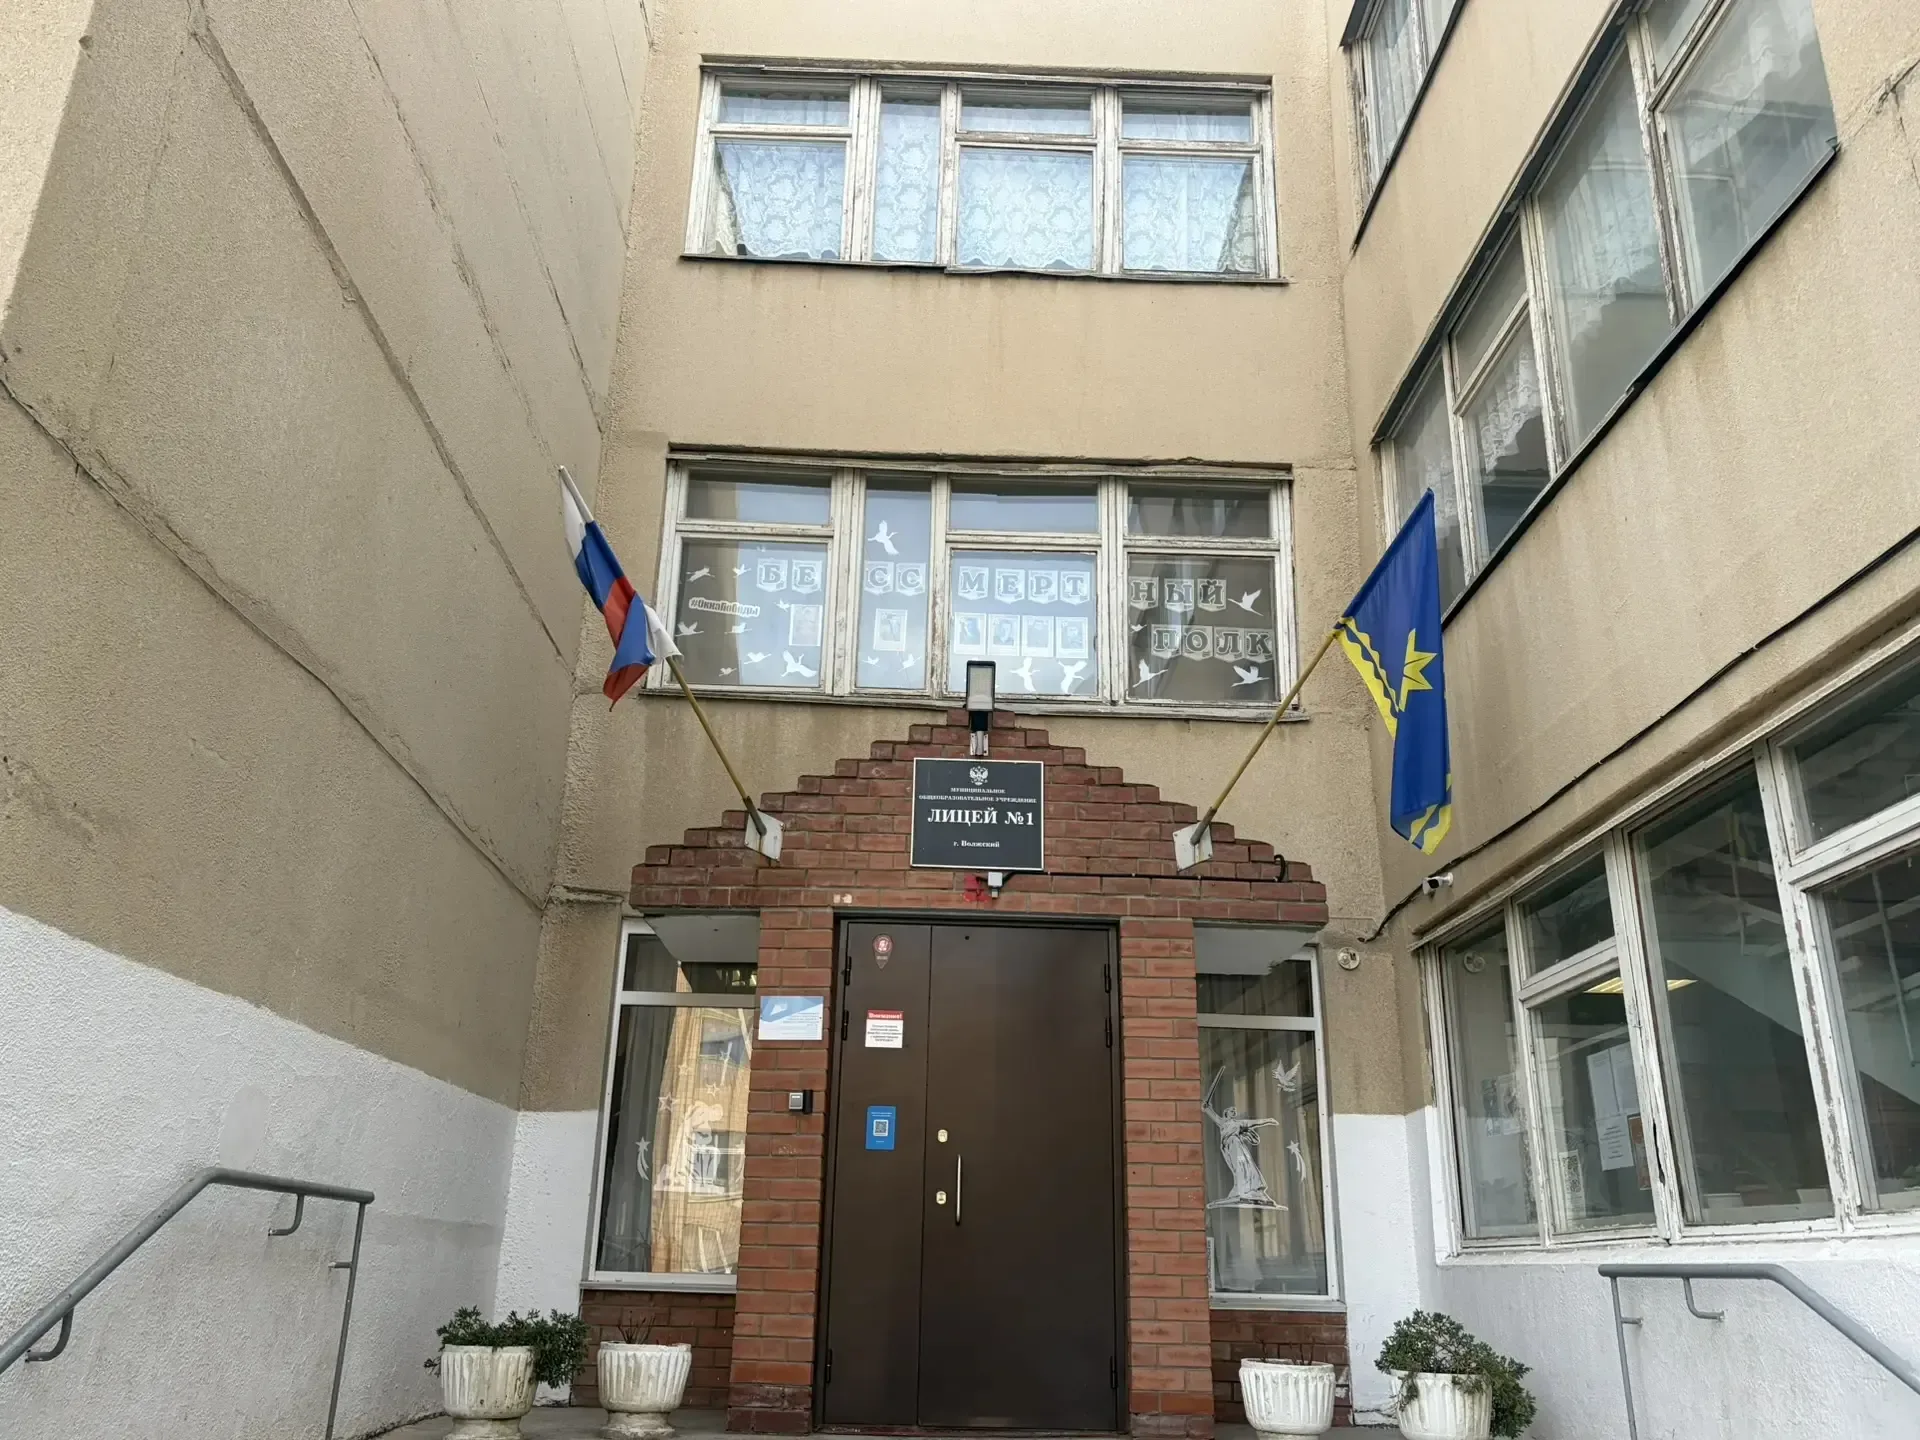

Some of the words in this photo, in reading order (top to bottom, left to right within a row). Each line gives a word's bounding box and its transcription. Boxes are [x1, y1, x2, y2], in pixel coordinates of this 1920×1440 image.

[1153, 629, 1272, 655] ПОЛК
[918, 794, 995, 802] ОБЩЕОБРАЗОВАТЕЛЬНОЕ
[927, 807, 998, 826] ЛИЦЕЙ
[1004, 811, 1034, 825] №1
[961, 840, 1000, 848] Волжский
